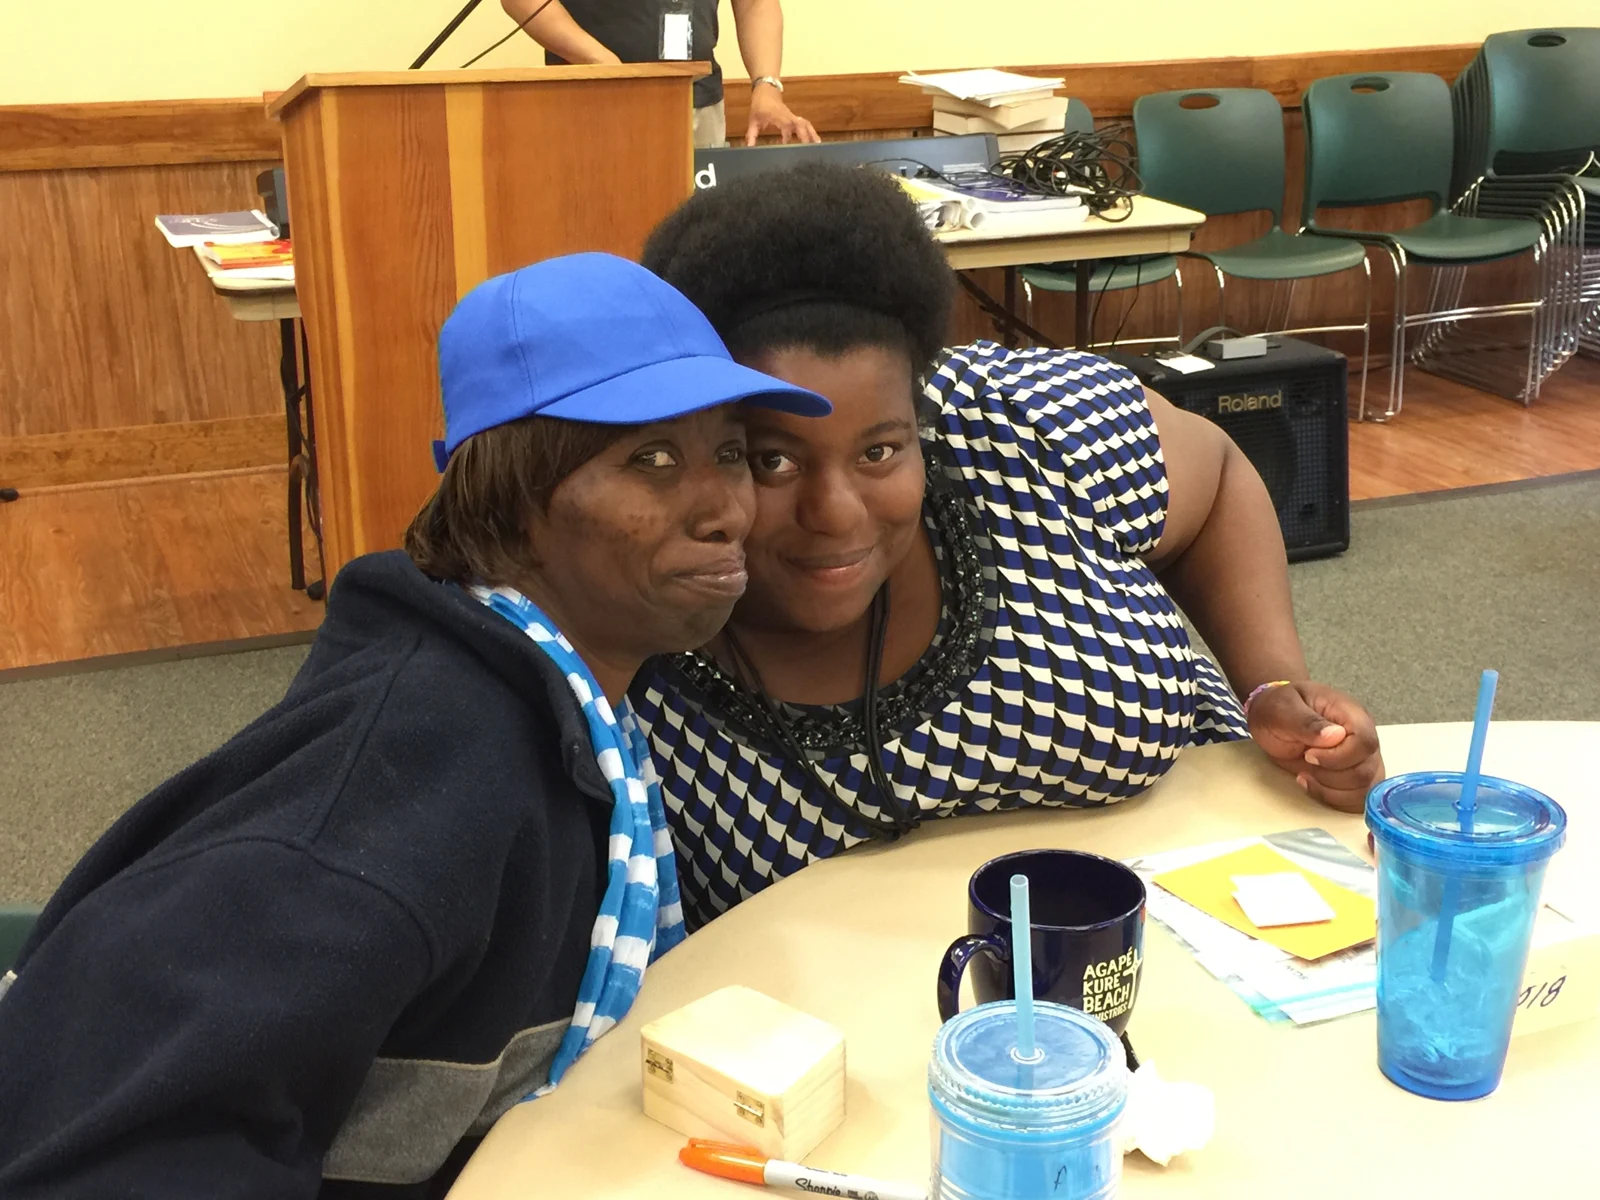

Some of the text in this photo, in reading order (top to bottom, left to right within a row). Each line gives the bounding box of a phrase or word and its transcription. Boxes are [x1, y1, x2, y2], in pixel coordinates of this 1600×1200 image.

[693, 163, 717, 189] d
[1218, 390, 1282, 413] Roland
[1083, 946, 1133, 980] AGAPÉ
[1083, 973, 1121, 995] KURE
[1083, 983, 1130, 1013] BEACH
[1091, 1001, 1128, 1022] NISTRIES
